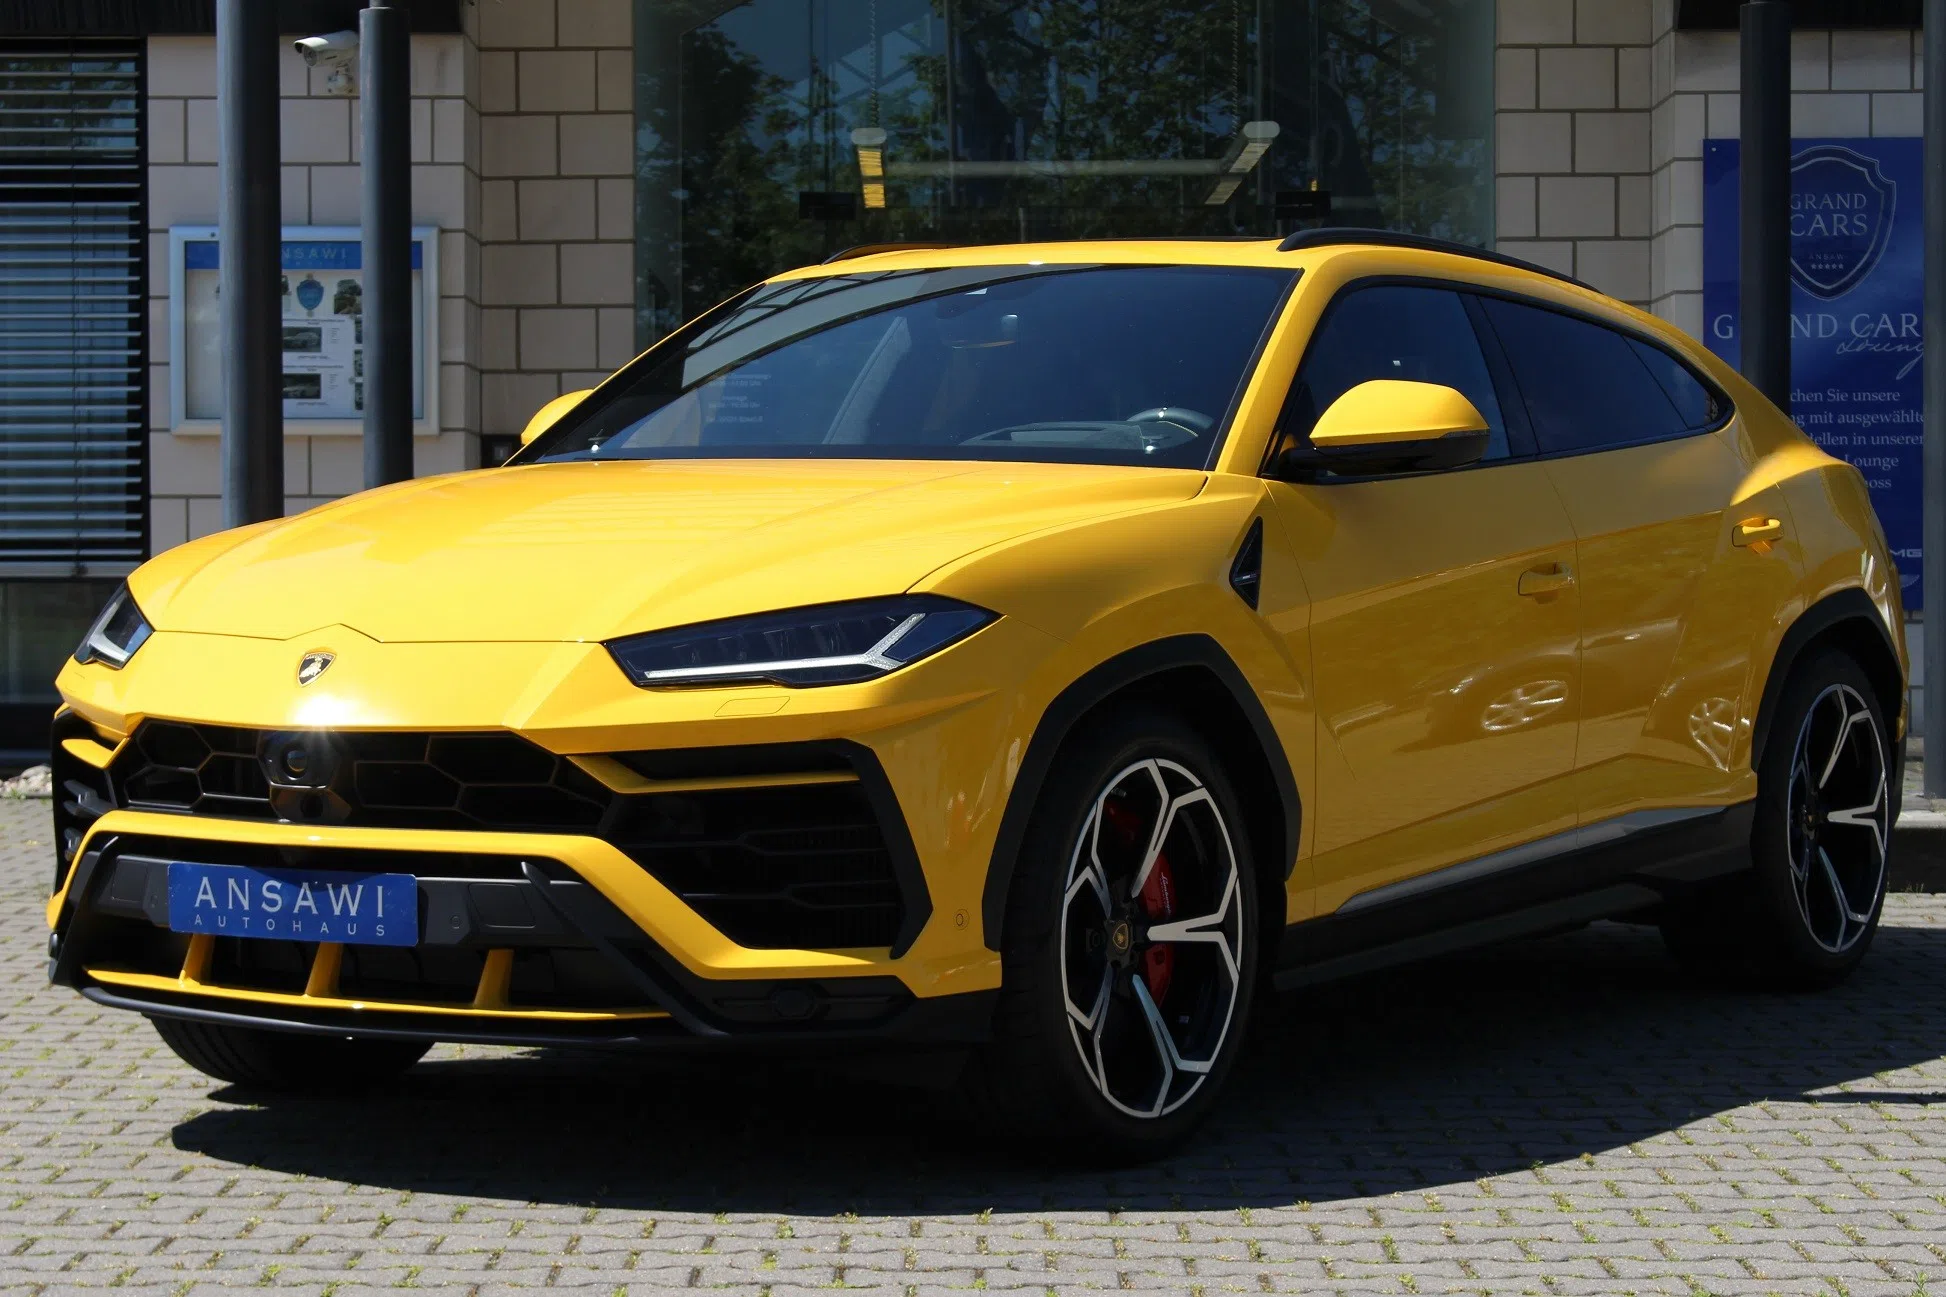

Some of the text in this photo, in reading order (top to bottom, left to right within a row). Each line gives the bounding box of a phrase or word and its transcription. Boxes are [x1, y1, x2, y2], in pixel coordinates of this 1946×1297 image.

[1790, 193, 1867, 210] GRAND
[1790, 213, 1868, 237] CARS
[281, 247, 347, 260] NSAWI
[1713, 313, 1921, 339] GND CAR
[1827, 388, 1849, 402] Sie
[1853, 391, 1901, 402] unsere
[1810, 411, 1835, 424] mit
[1853, 433, 1867, 445] in
[1864, 478, 1892, 489] oss
[194, 876, 383, 918] ANSAWI
[194, 914, 385, 936] AUTOHAUS
